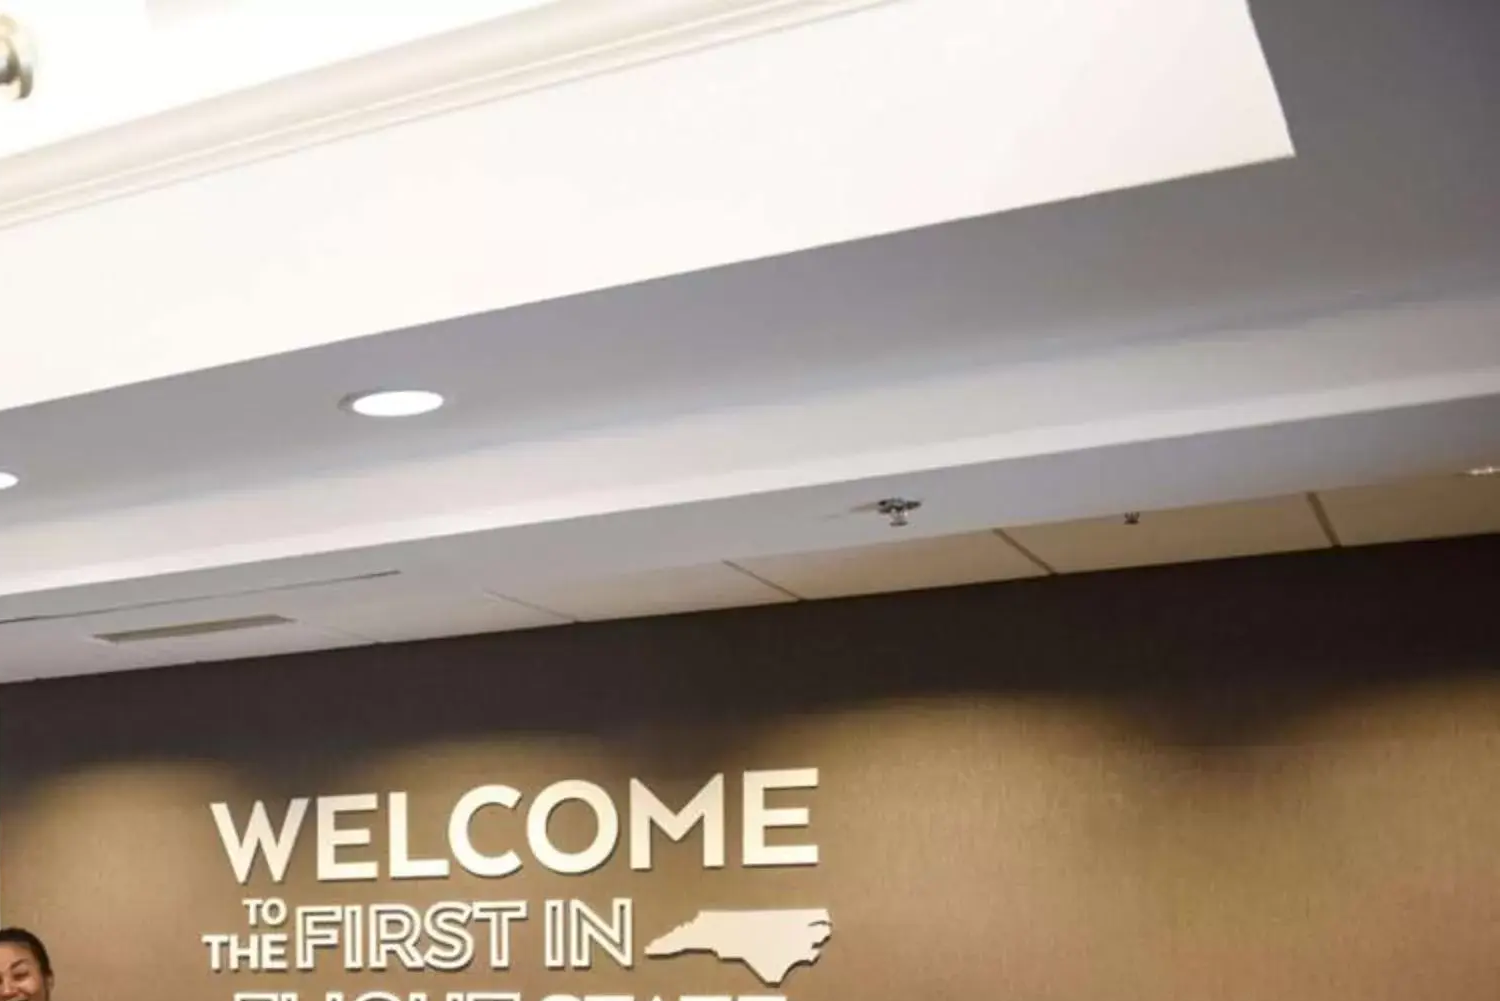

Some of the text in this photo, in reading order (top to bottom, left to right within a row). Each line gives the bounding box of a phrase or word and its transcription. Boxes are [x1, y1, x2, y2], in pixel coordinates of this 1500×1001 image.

[209, 768, 819, 884] WELCOME
[242, 898, 288, 926] TO
[296, 898, 633, 970] FIRST IN
[201, 934, 289, 972] THE
